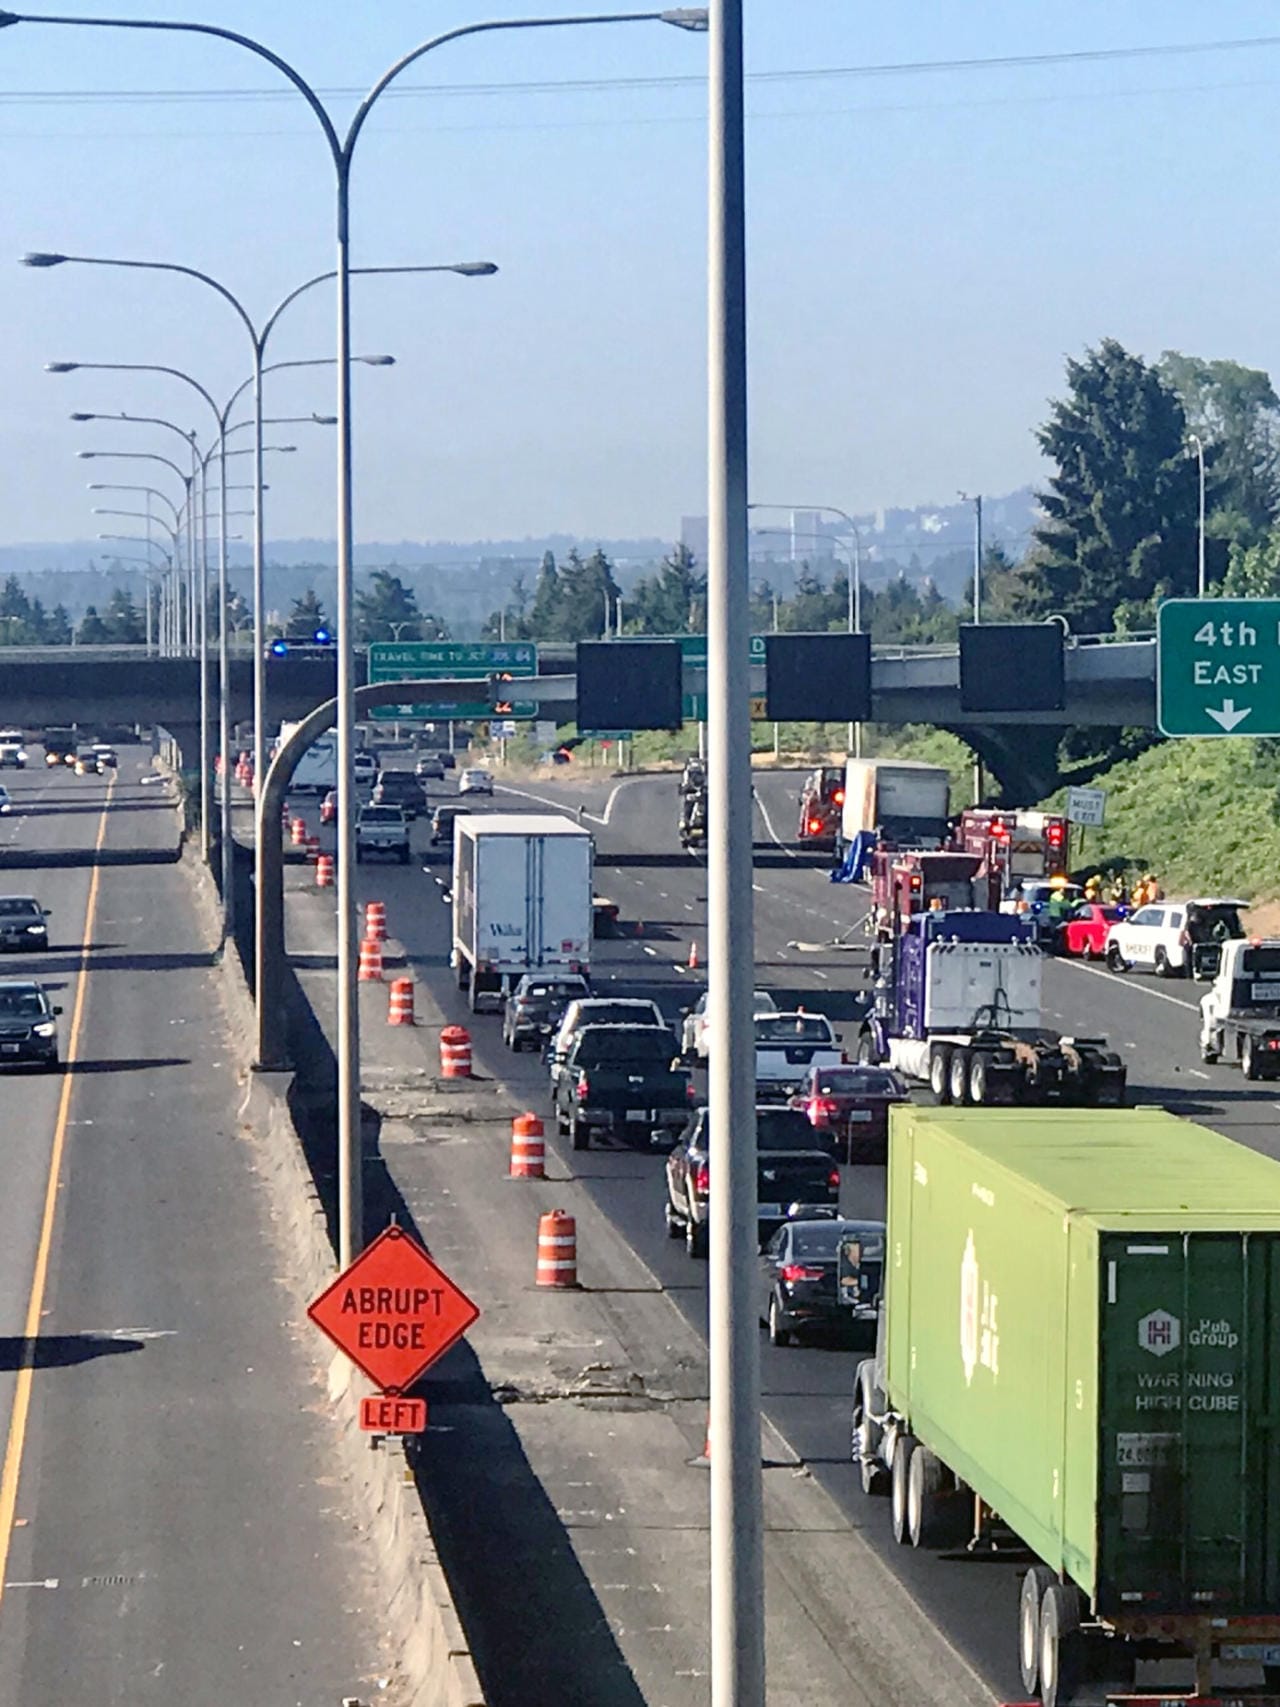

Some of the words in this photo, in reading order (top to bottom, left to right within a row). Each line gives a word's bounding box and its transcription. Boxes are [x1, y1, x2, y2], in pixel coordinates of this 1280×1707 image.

[1194, 622, 1256, 647] 4th
[1194, 661, 1262, 684] EAST
[341, 1288, 445, 1316] ABRUPT
[358, 1323, 426, 1350] EDGE
[1199, 1319, 1230, 1333] Hub
[1189, 1329, 1239, 1348] Group
[1135, 1395, 1181, 1411] HIGH
[1188, 1395, 1240, 1411] CUBE
[364, 1403, 421, 1427] LEFT
